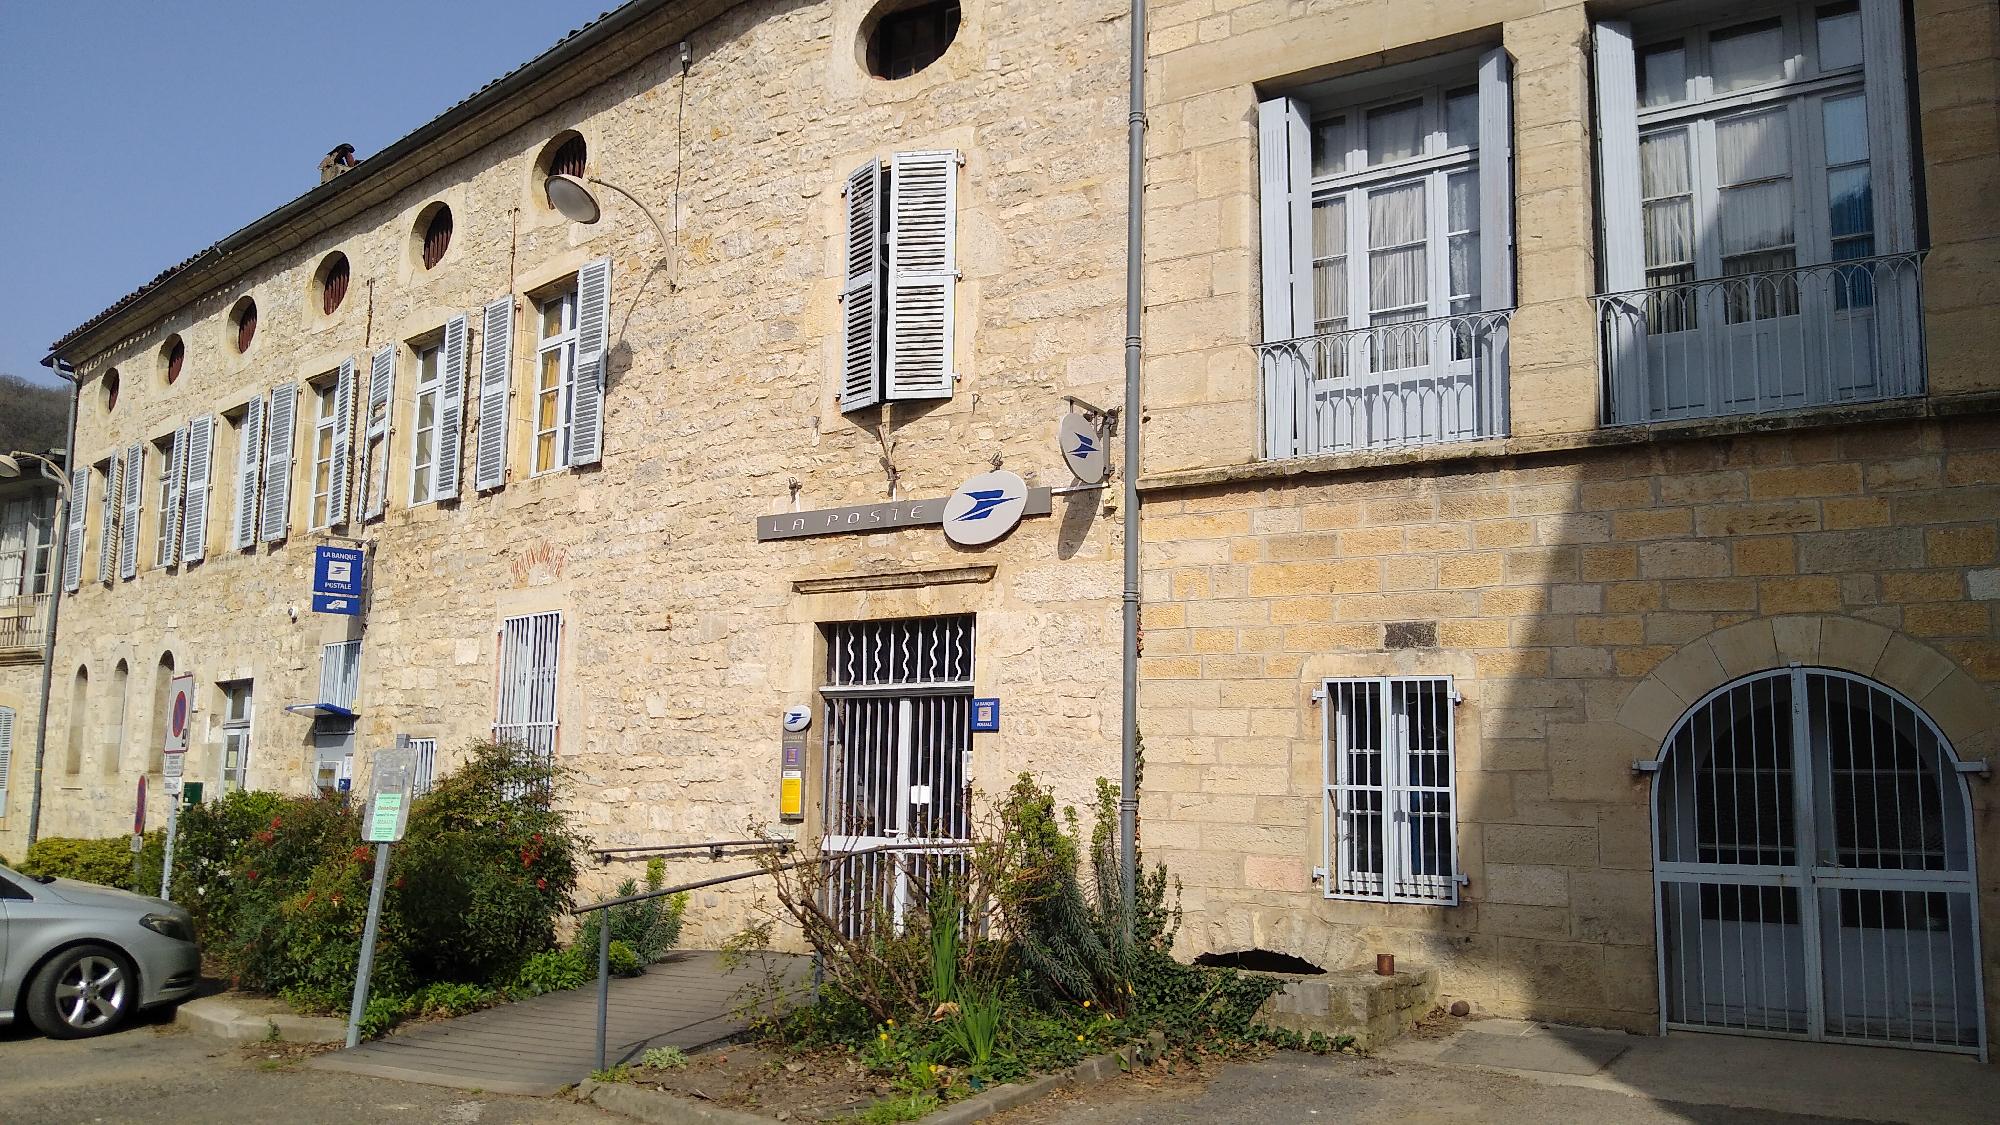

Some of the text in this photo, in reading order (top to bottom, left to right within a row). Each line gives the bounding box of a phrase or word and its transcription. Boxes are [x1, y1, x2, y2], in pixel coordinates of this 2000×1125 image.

[773, 505, 924, 532] LA POSTE
[331, 552, 358, 560] BANQUE
[324, 581, 352, 590] POSTALE
